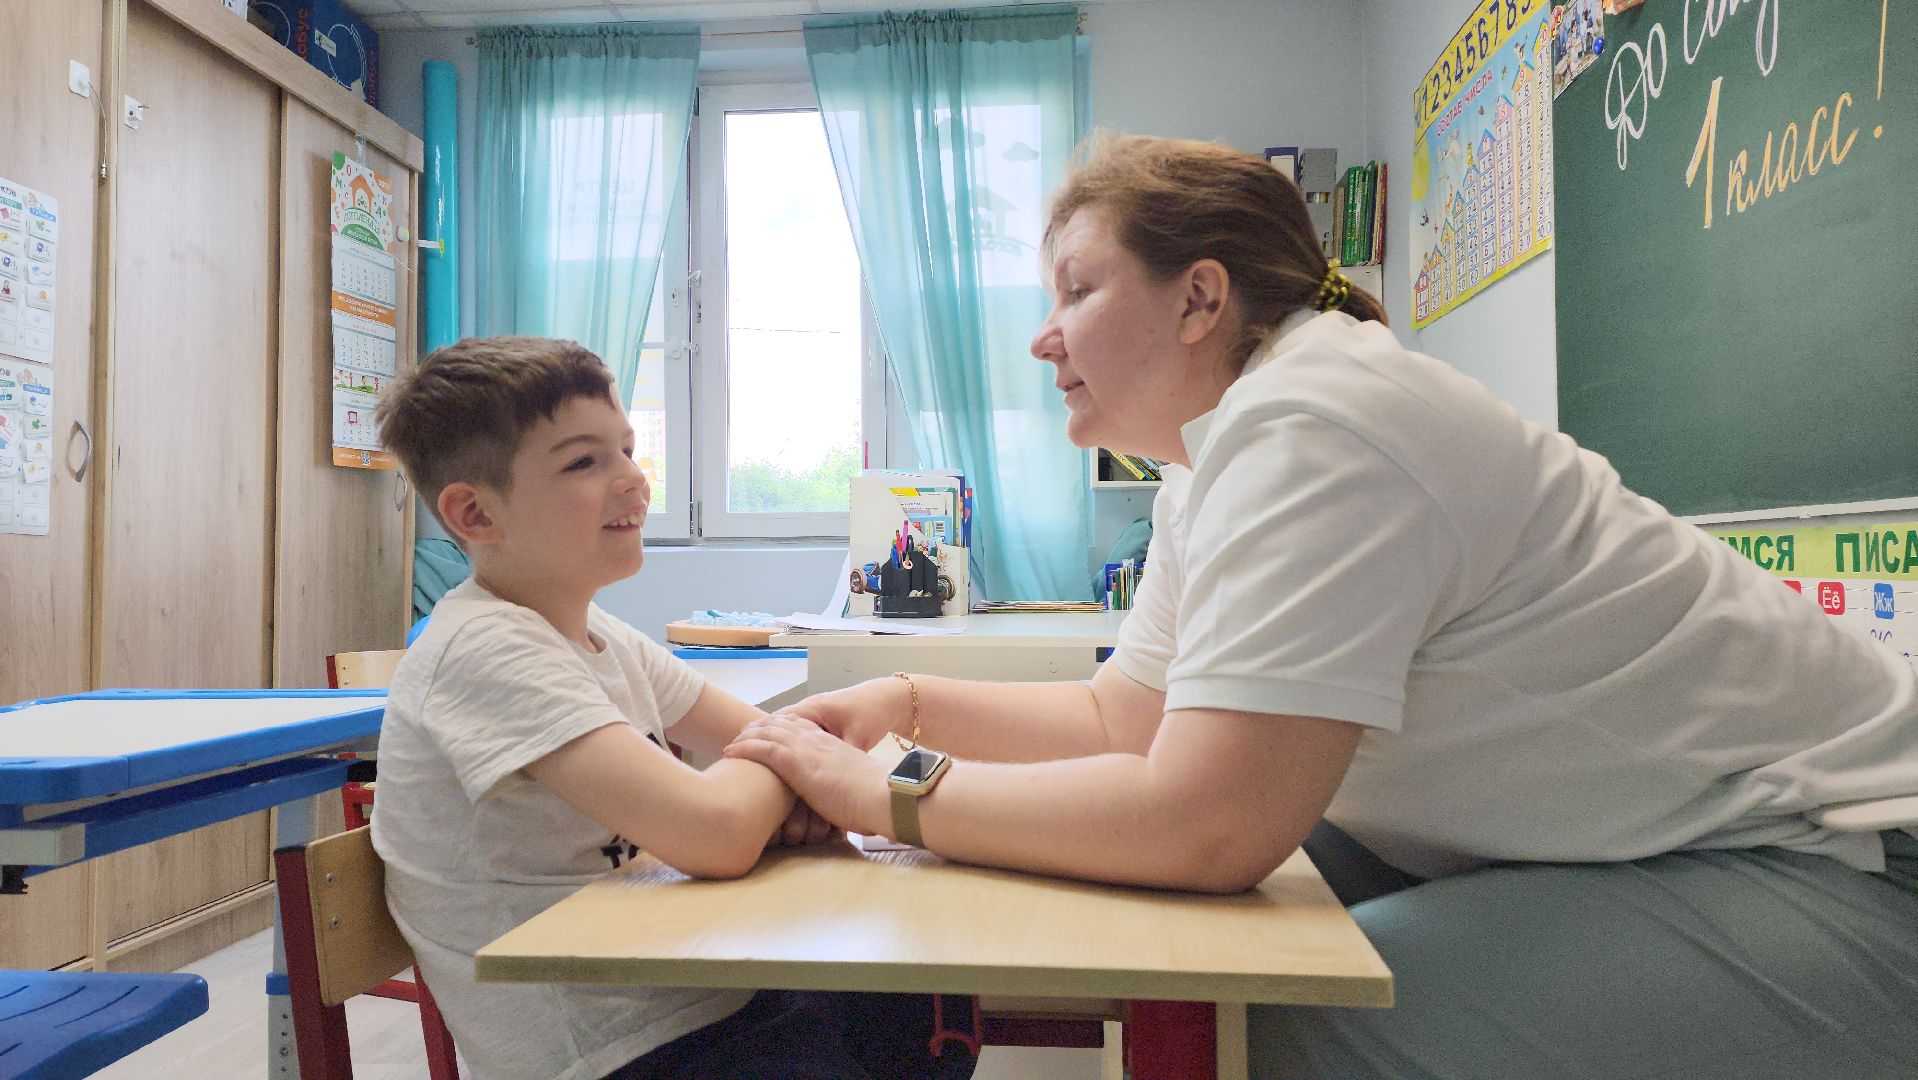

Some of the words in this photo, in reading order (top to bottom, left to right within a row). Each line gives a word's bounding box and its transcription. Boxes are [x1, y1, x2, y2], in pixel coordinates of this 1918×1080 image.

[1685, 76, 1723, 229] 1
[1718, 535, 1795, 571] МСЯ
[1822, 587, 1841, 609] Ёё
[1874, 591, 1895, 613] Жж
